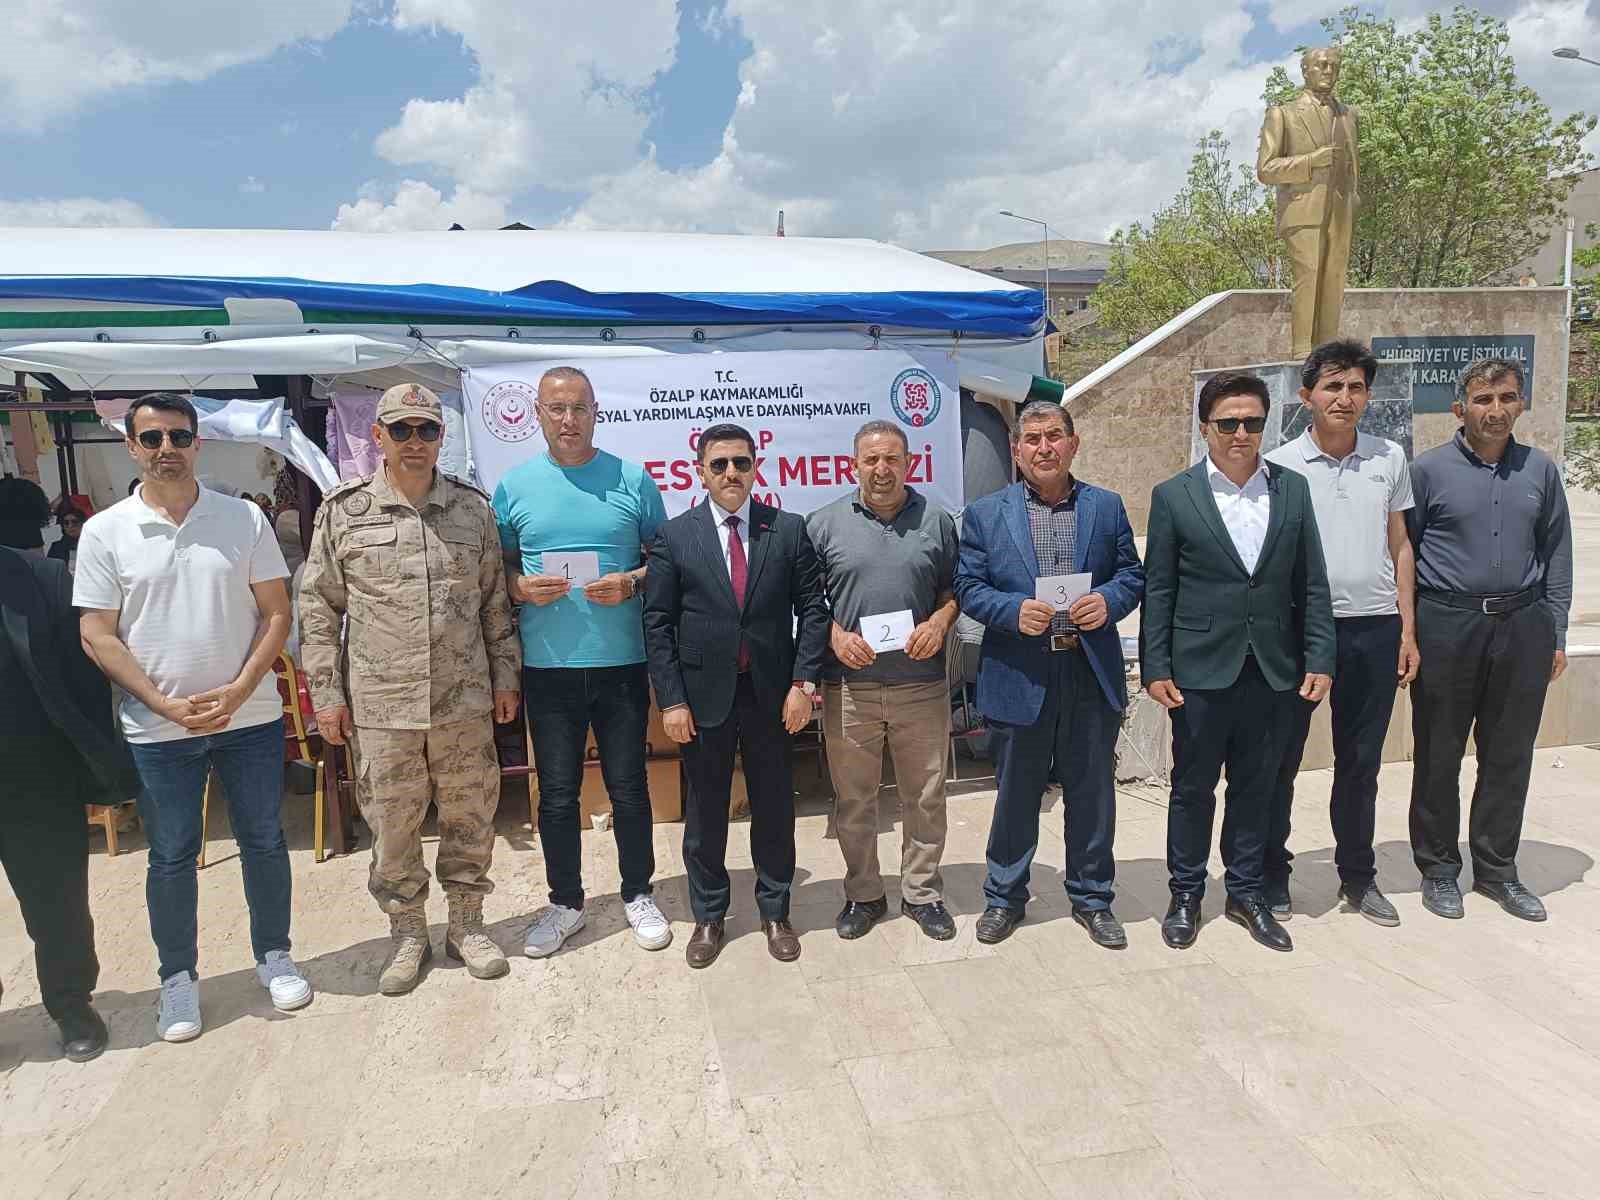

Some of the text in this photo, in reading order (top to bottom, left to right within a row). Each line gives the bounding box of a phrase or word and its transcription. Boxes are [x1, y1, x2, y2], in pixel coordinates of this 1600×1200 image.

[1453, 347, 1469, 361] VE
[1472, 343, 1527, 361] İSTİKLAL
[714, 370, 738, 383] T.C.
[649, 383, 803, 403] ÖZALP KAYMAKAMLIĞI
[597, 402, 871, 424] SYAL YARDIMLAŞMA VE DAYANIŞMA VAKFI
[561, 562, 577, 579] 1
[1054, 585, 1068, 605] 3
[880, 624, 896, 643] 2
